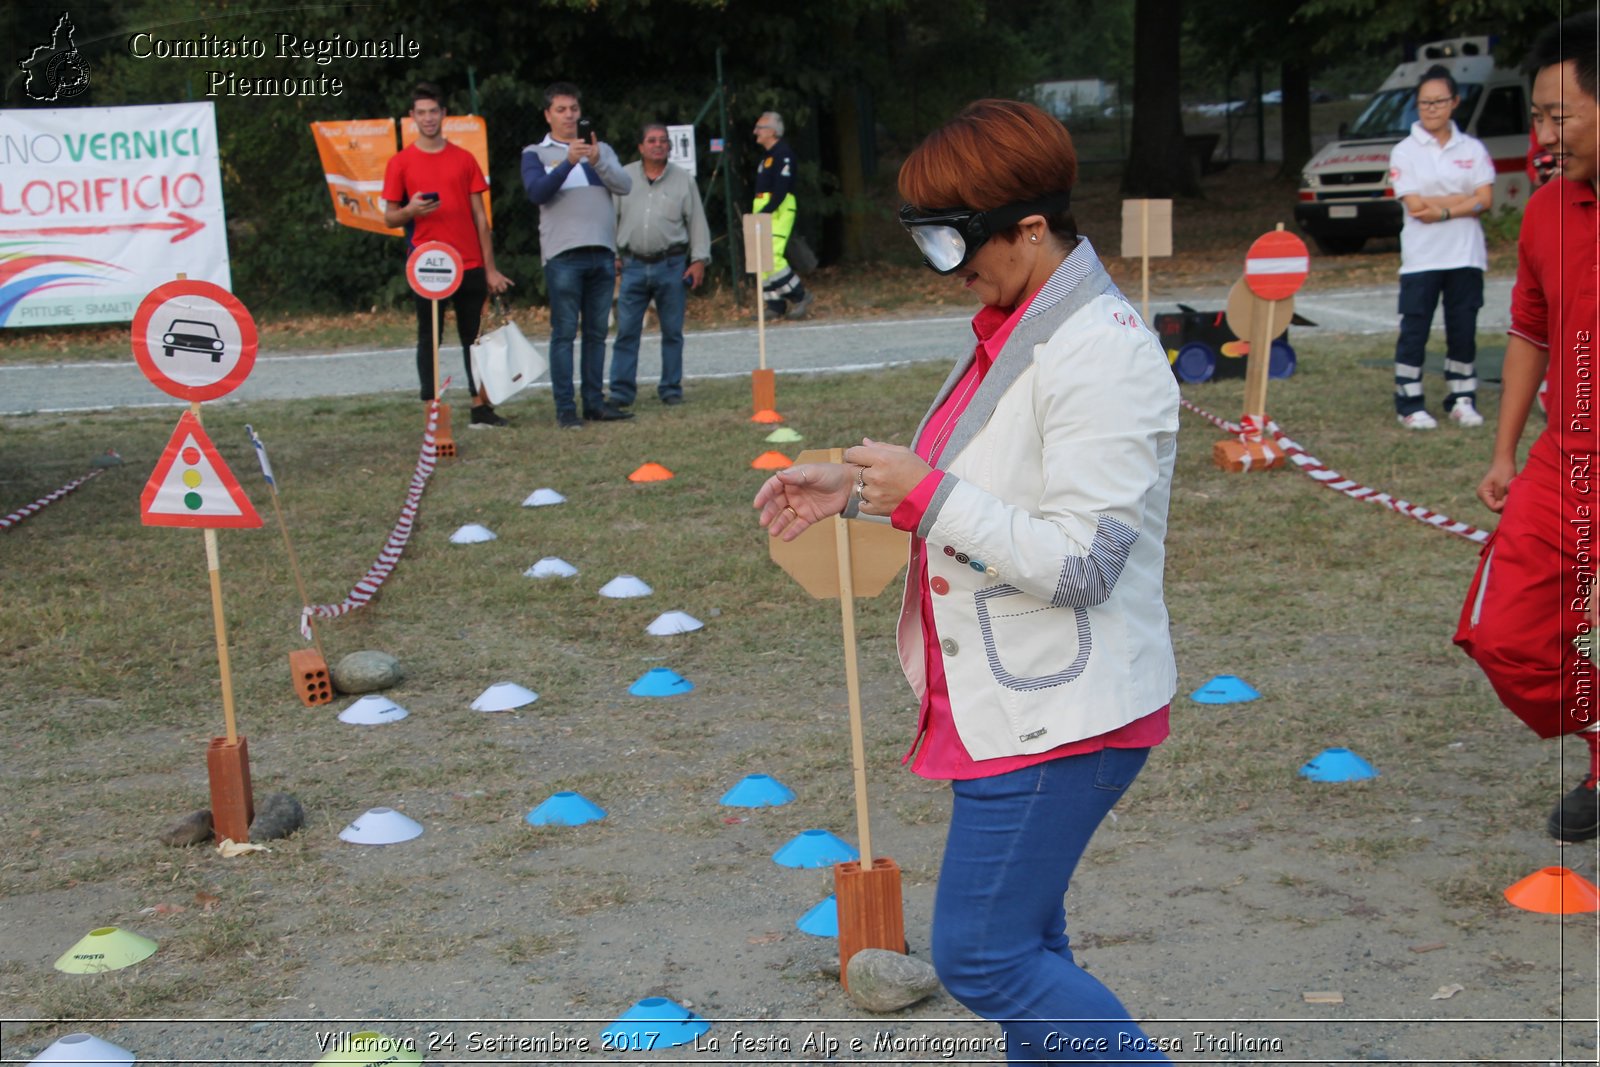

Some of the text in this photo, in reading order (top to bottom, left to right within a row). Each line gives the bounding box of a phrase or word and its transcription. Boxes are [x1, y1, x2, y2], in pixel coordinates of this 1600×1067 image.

[425, 257, 445, 267] ALT
[21, 304, 74, 318] PITTURE
[86, 302, 133, 316] SMALTI
